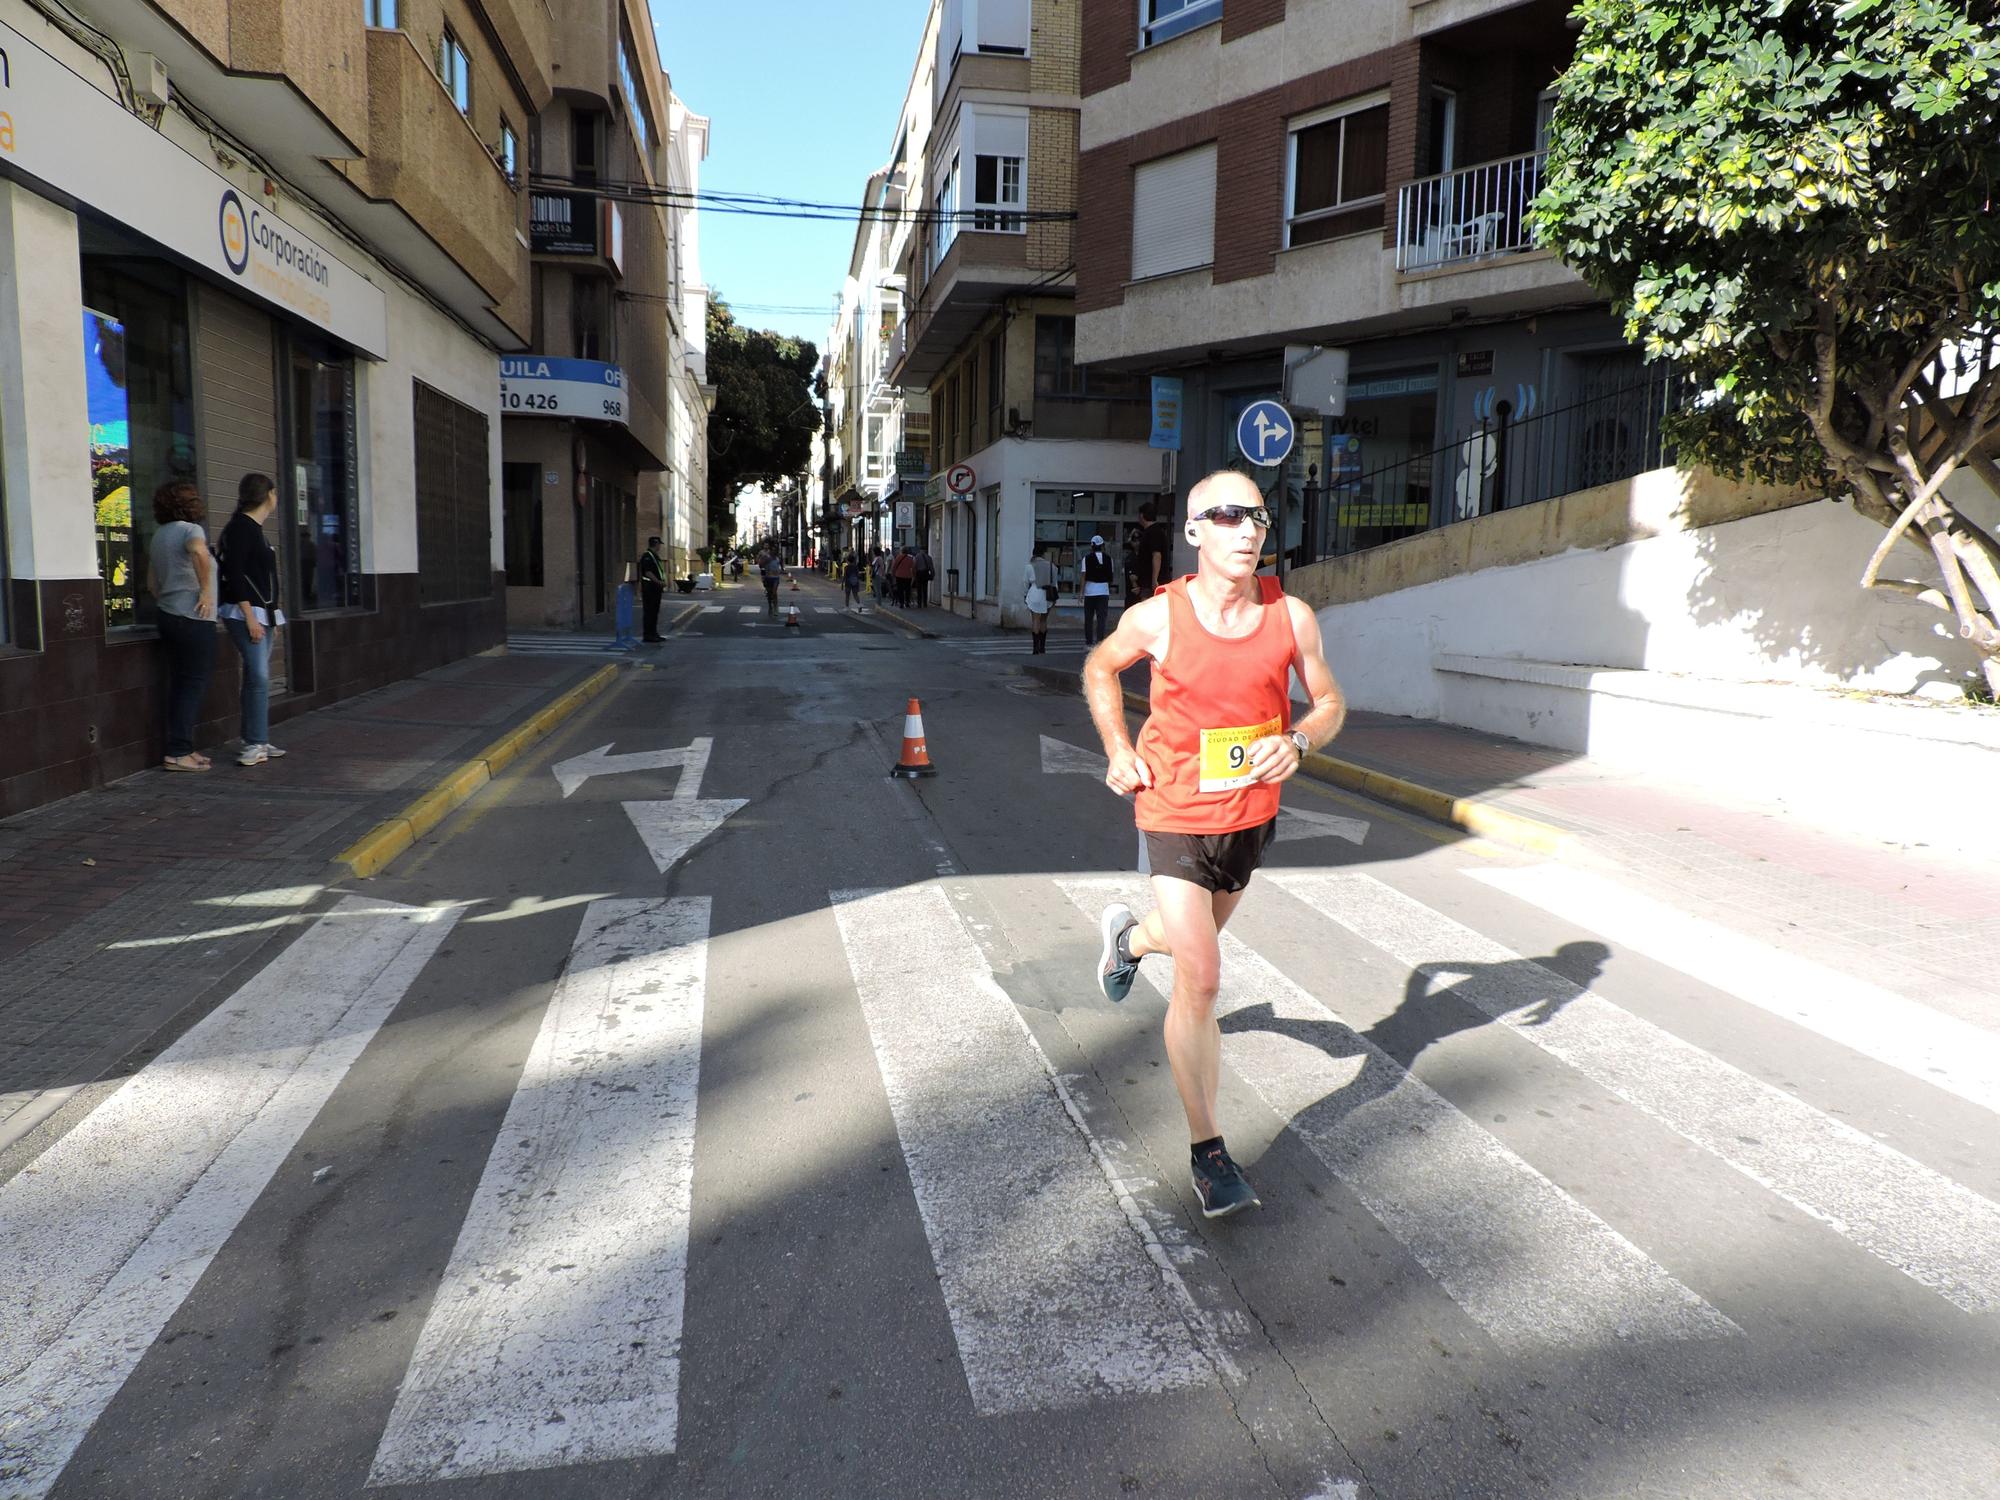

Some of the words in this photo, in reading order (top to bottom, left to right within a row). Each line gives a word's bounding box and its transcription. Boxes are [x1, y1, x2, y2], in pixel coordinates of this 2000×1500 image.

[251, 209, 329, 287] Corporación
[525, 394, 558, 410] 426
[603, 400, 621, 417] 968
[1207, 735, 1239, 744] CIUDAD
